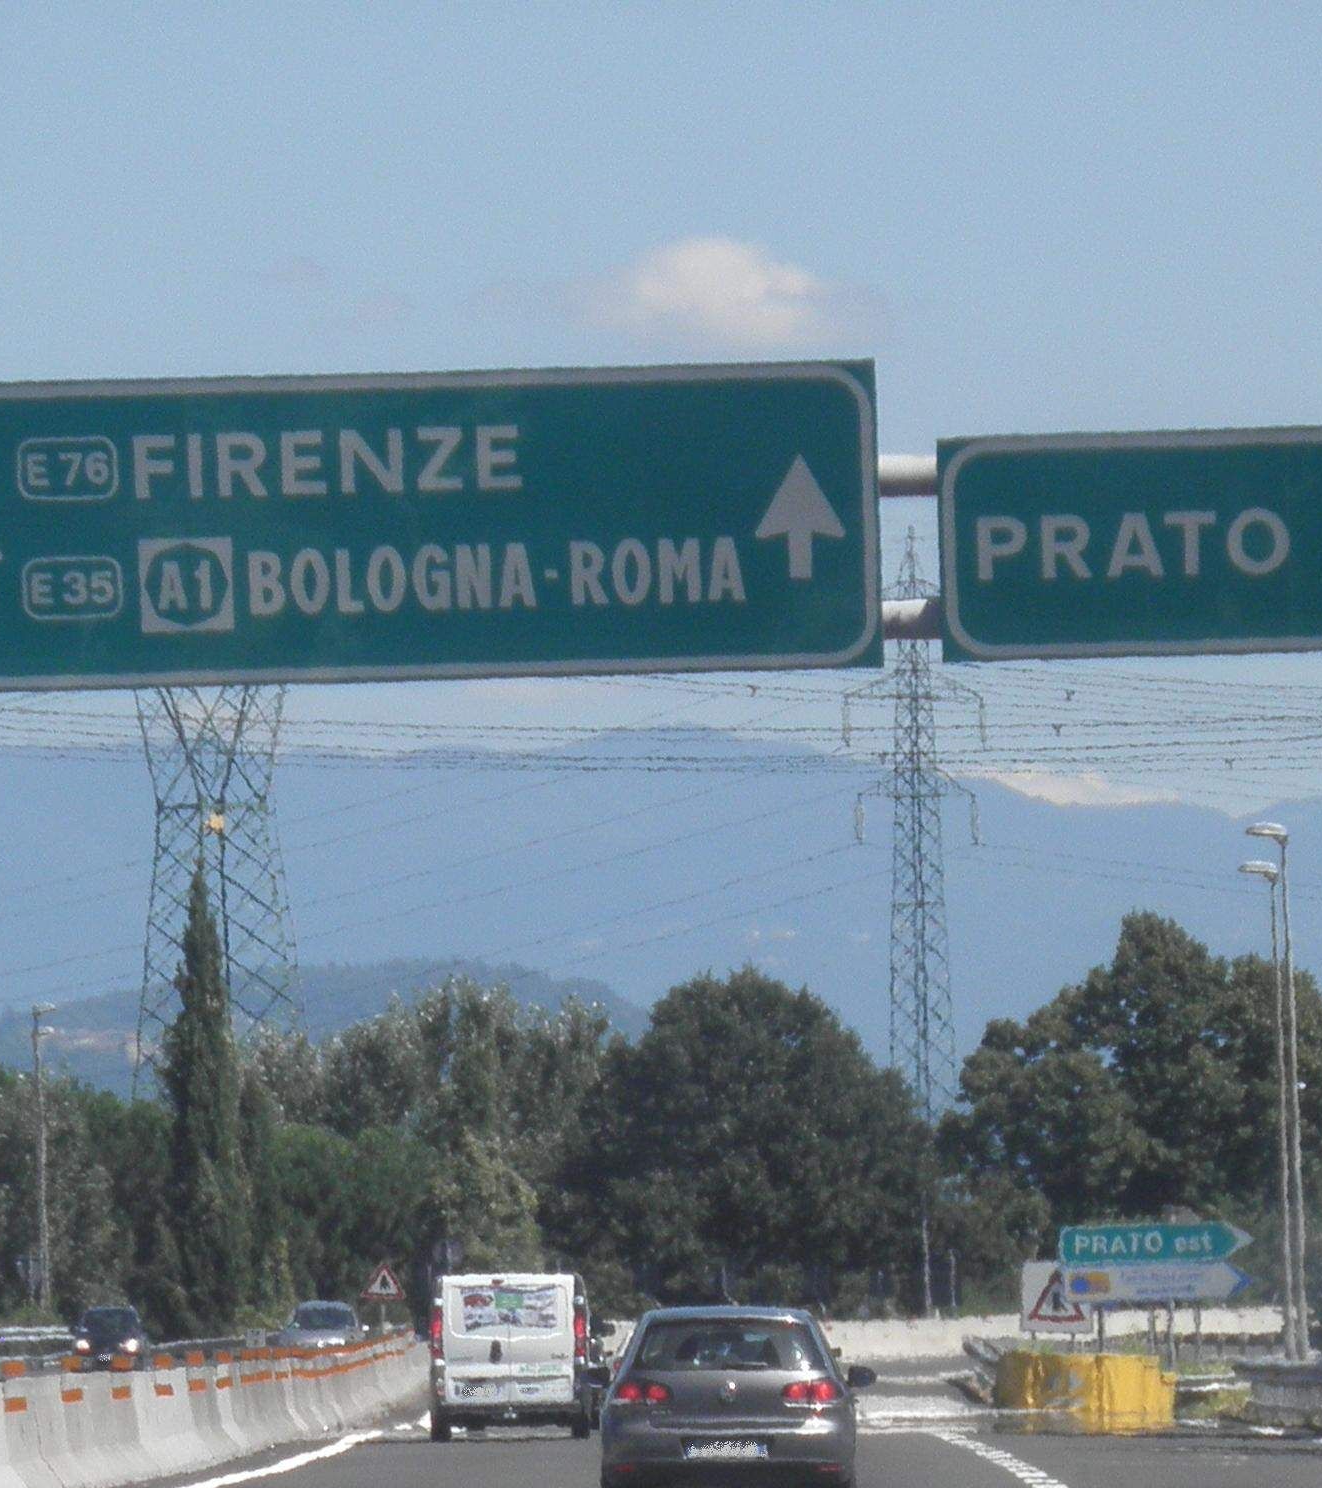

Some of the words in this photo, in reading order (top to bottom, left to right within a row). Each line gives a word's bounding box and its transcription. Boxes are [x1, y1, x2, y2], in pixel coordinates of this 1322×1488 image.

[26, 456, 49, 487] E
[60, 452, 110, 486] 76
[133, 425, 522, 499] FIRENZE
[976, 508, 1290, 581] PRATO
[30, 574, 53, 604] E
[64, 571, 115, 604] 35
[159, 560, 211, 610] A1
[1074, 1230, 1164, 1255] PRATO
[1174, 1231, 1214, 1253] est
